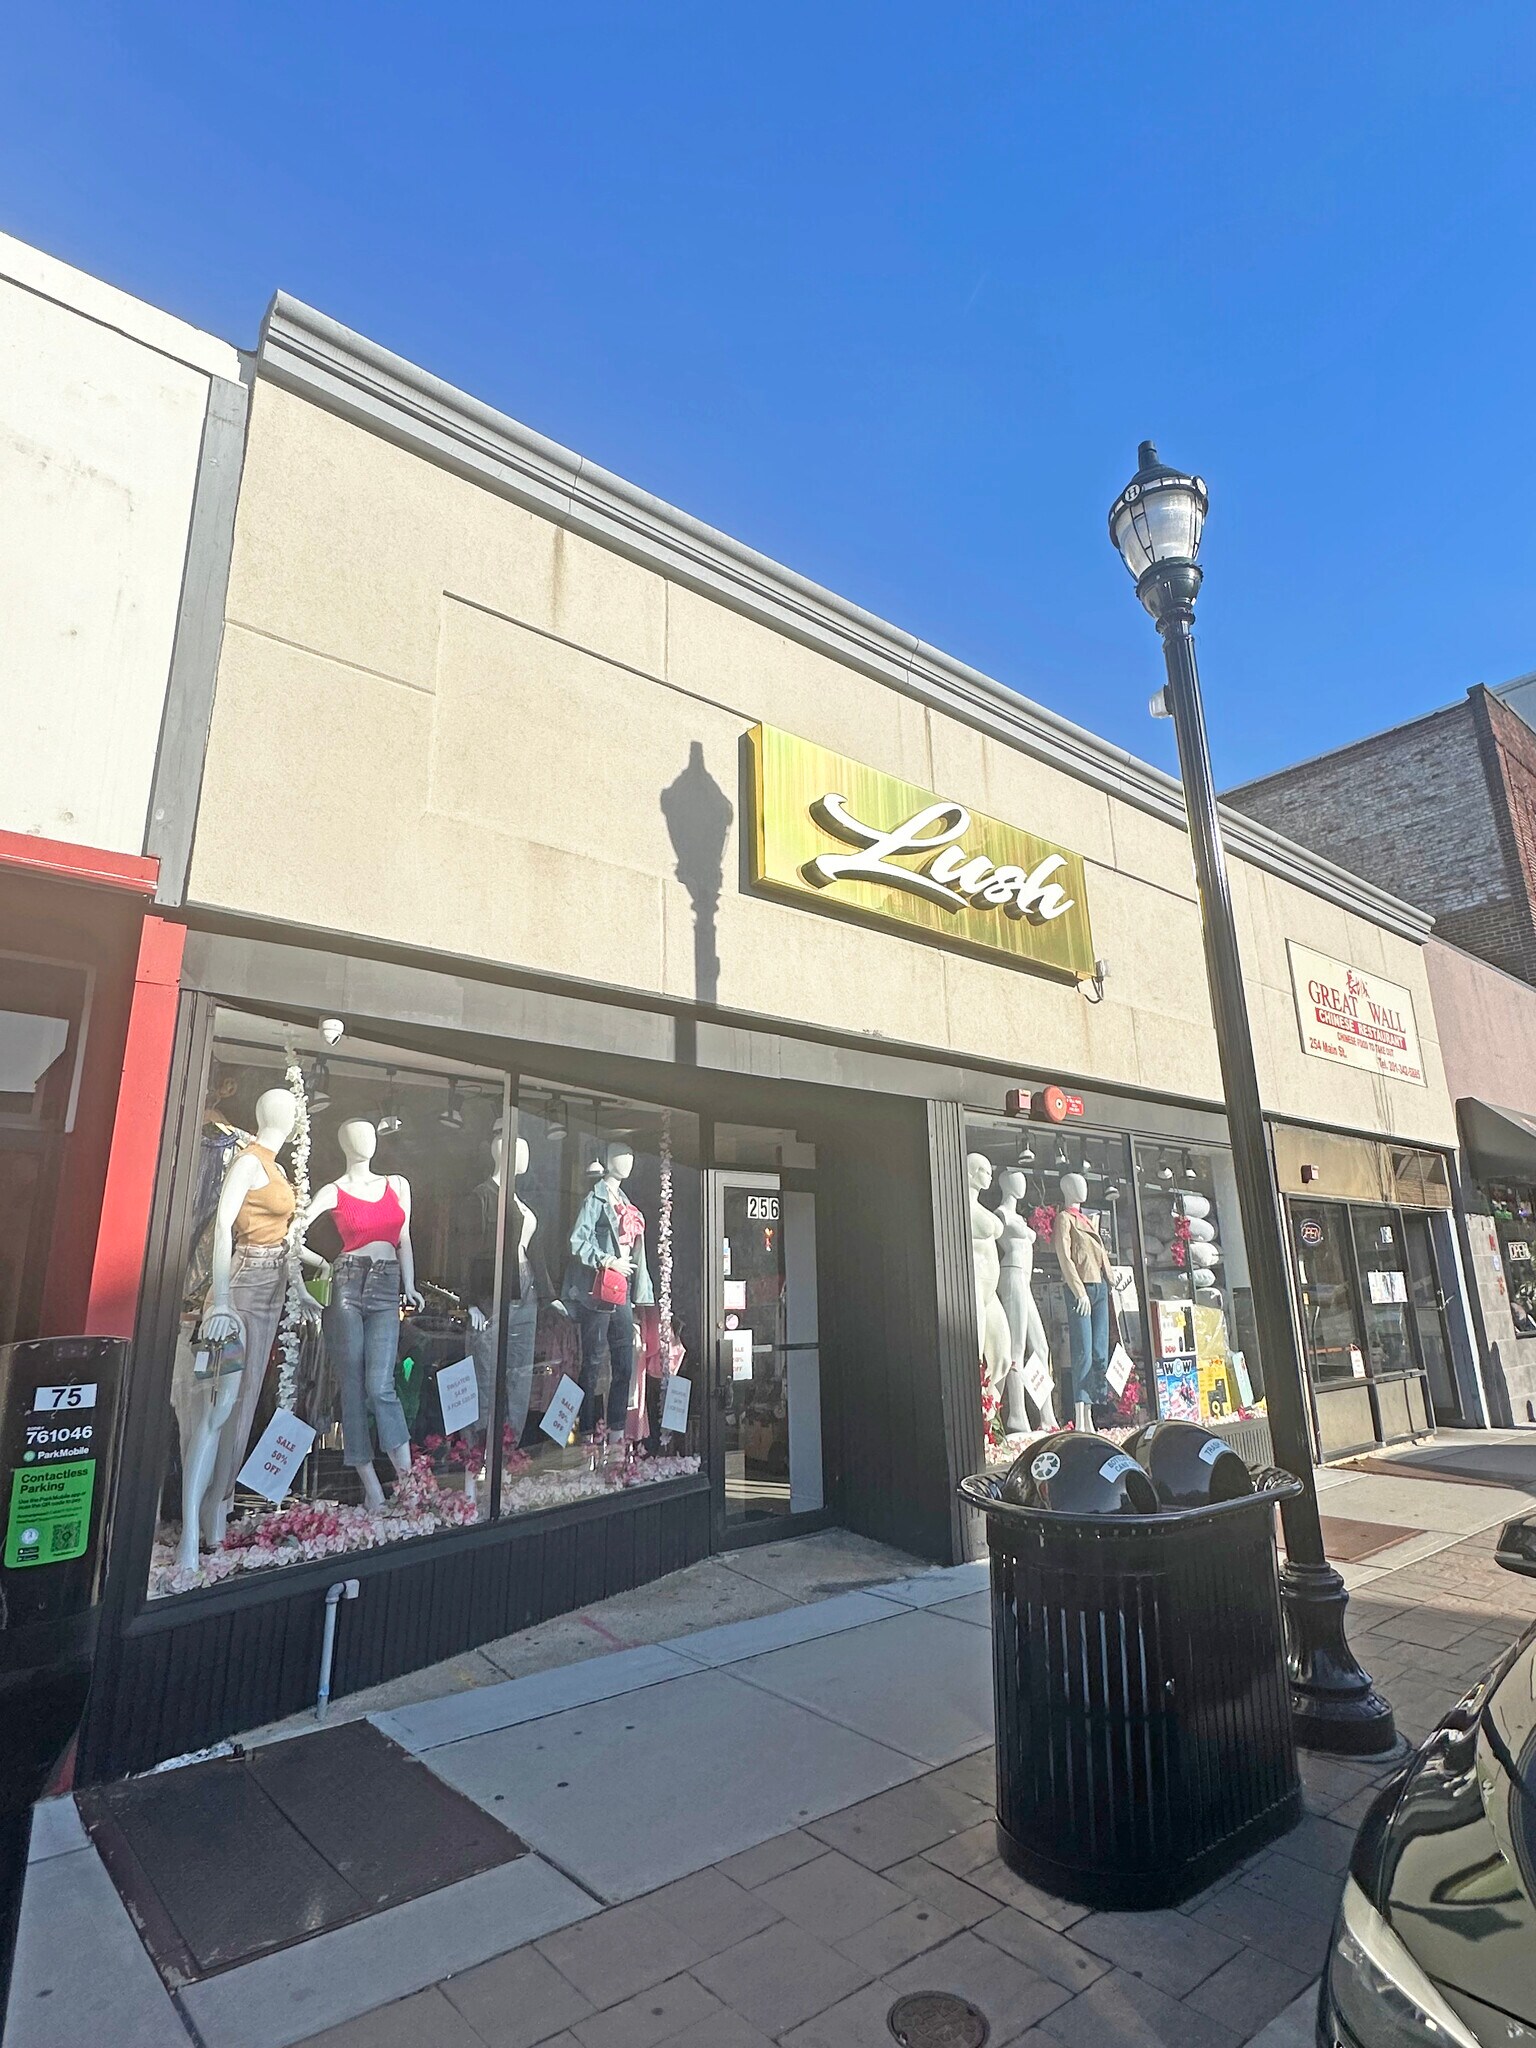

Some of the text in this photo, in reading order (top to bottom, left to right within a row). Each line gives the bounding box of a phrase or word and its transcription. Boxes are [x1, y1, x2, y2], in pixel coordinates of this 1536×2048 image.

[812, 792, 1075, 921] Lush
[1308, 980, 1406, 1034] GREAT WALL
[1318, 1009, 1404, 1048] CHINESE RESTAURANT
[1322, 1041, 1338, 1055] Main
[749, 1198, 778, 1218] 256
[1510, 1243, 1530, 1258] OPEN
[1164, 1359, 1191, 1377] WOW
[52, 1387, 82, 1408] 75
[26, 1425, 93, 1445] 761046
[276, 1436, 296, 1452] SALE
[37, 1446, 90, 1460] ParkMobile
[271, 1450, 288, 1465] 50%
[21, 1467, 88, 1484] Contactless
[264, 1462, 281, 1475] OFF
[20, 1481, 65, 1494] Parking
